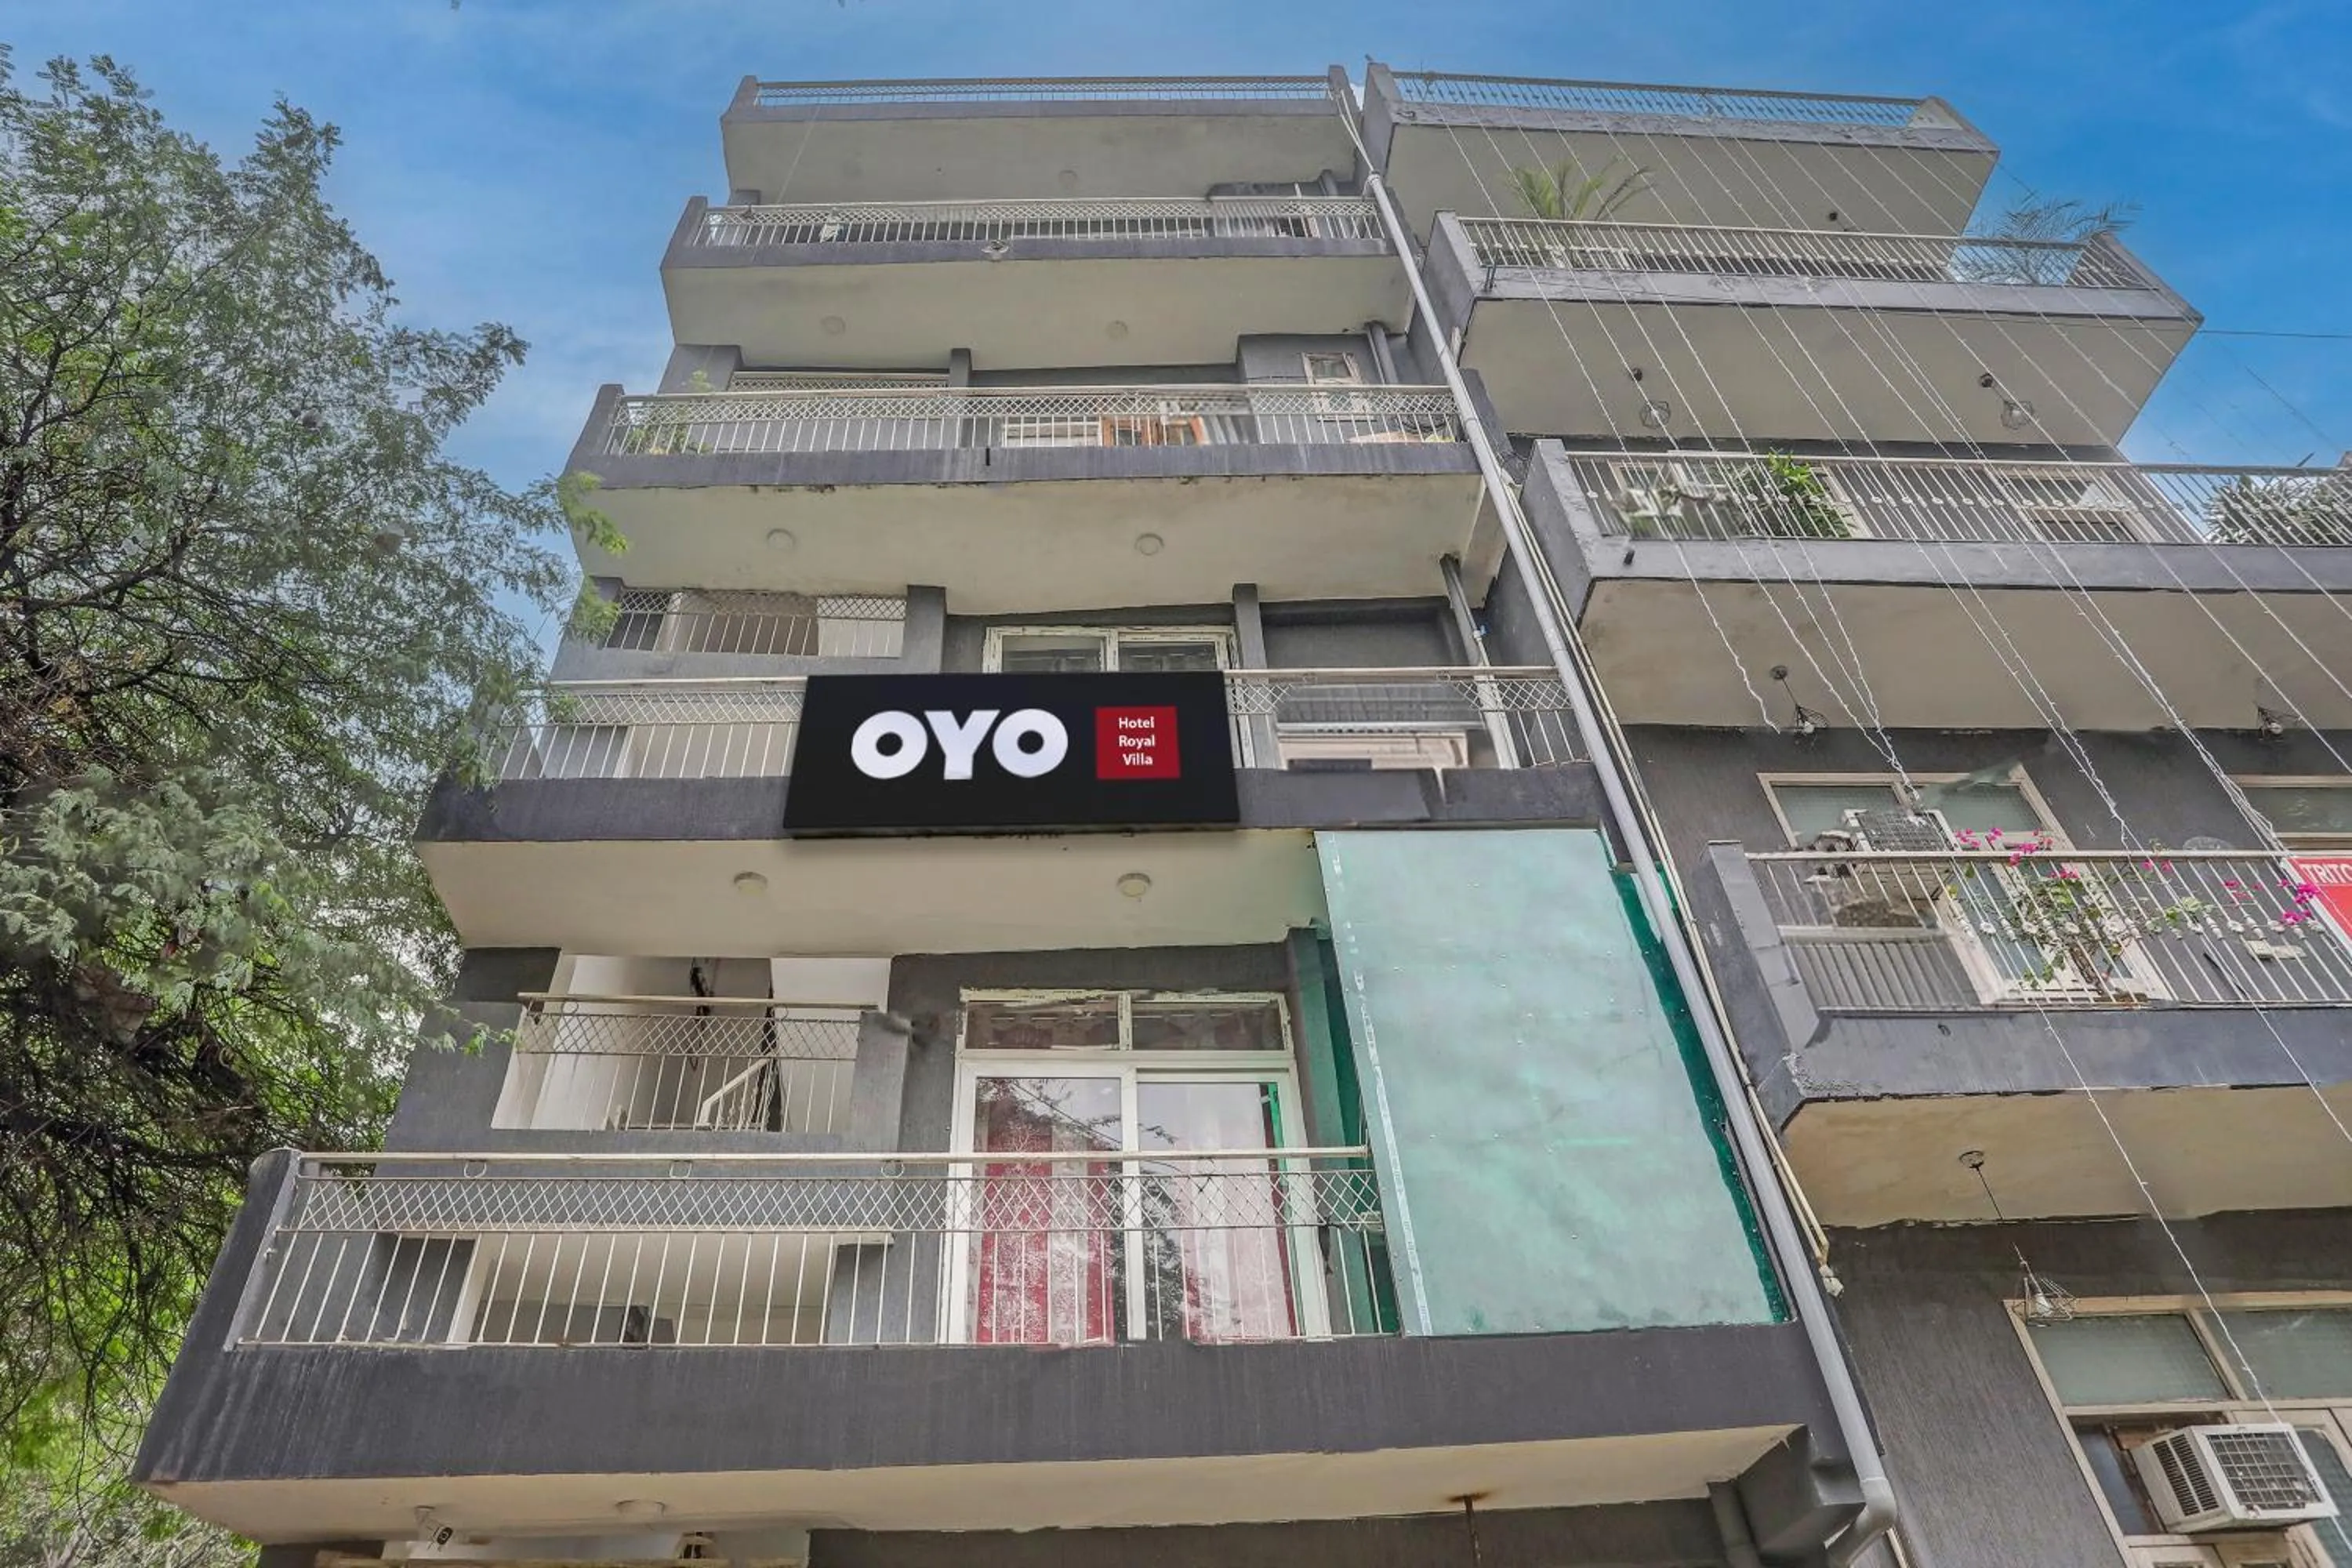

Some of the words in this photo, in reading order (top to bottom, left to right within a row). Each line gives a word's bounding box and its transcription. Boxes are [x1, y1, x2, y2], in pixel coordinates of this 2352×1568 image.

[1119, 716, 1155, 729] Hotel
[851, 708, 1069, 780] OYO
[1119, 734, 1156, 750] Royal
[1122, 752, 1153, 766] Villa
